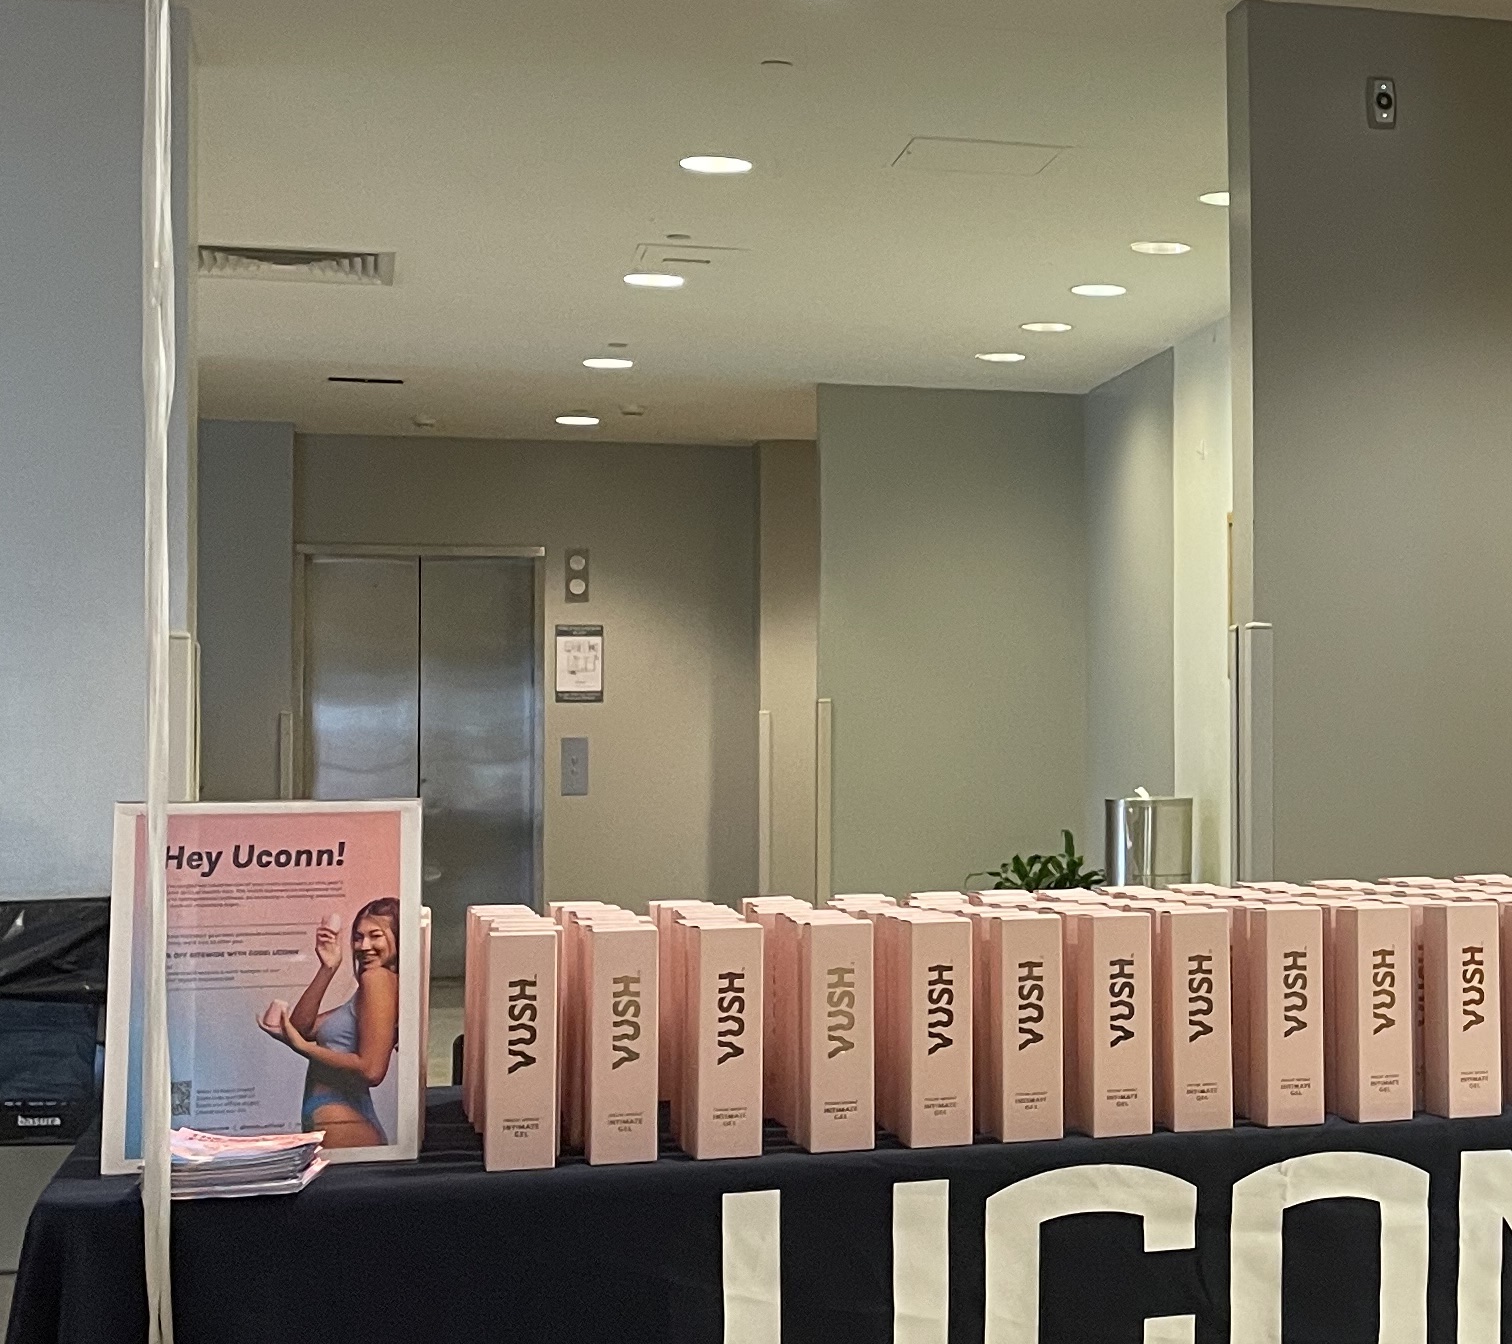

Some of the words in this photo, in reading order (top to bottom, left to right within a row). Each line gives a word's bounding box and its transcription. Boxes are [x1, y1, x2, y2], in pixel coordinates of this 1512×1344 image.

[165, 846, 223, 878] Hey
[232, 842, 346, 869] Uconn!
[507, 979, 538, 1074] VUSH
[612, 975, 641, 1070] VUSH
[717, 971, 745, 1065] VUSH
[827, 966, 856, 1059] VUSH
[927, 964, 954, 1055] VUSH
[1018, 961, 1044, 1051] VUSH
[1109, 958, 1135, 1048] VUSH
[1188, 954, 1213, 1043] VUSH
[1283, 950, 1308, 1038] VUSH
[1372, 948, 1396, 1035] VUSH
[1462, 946, 1485, 1032] VUSH
[17, 1115, 61, 1126] basura
